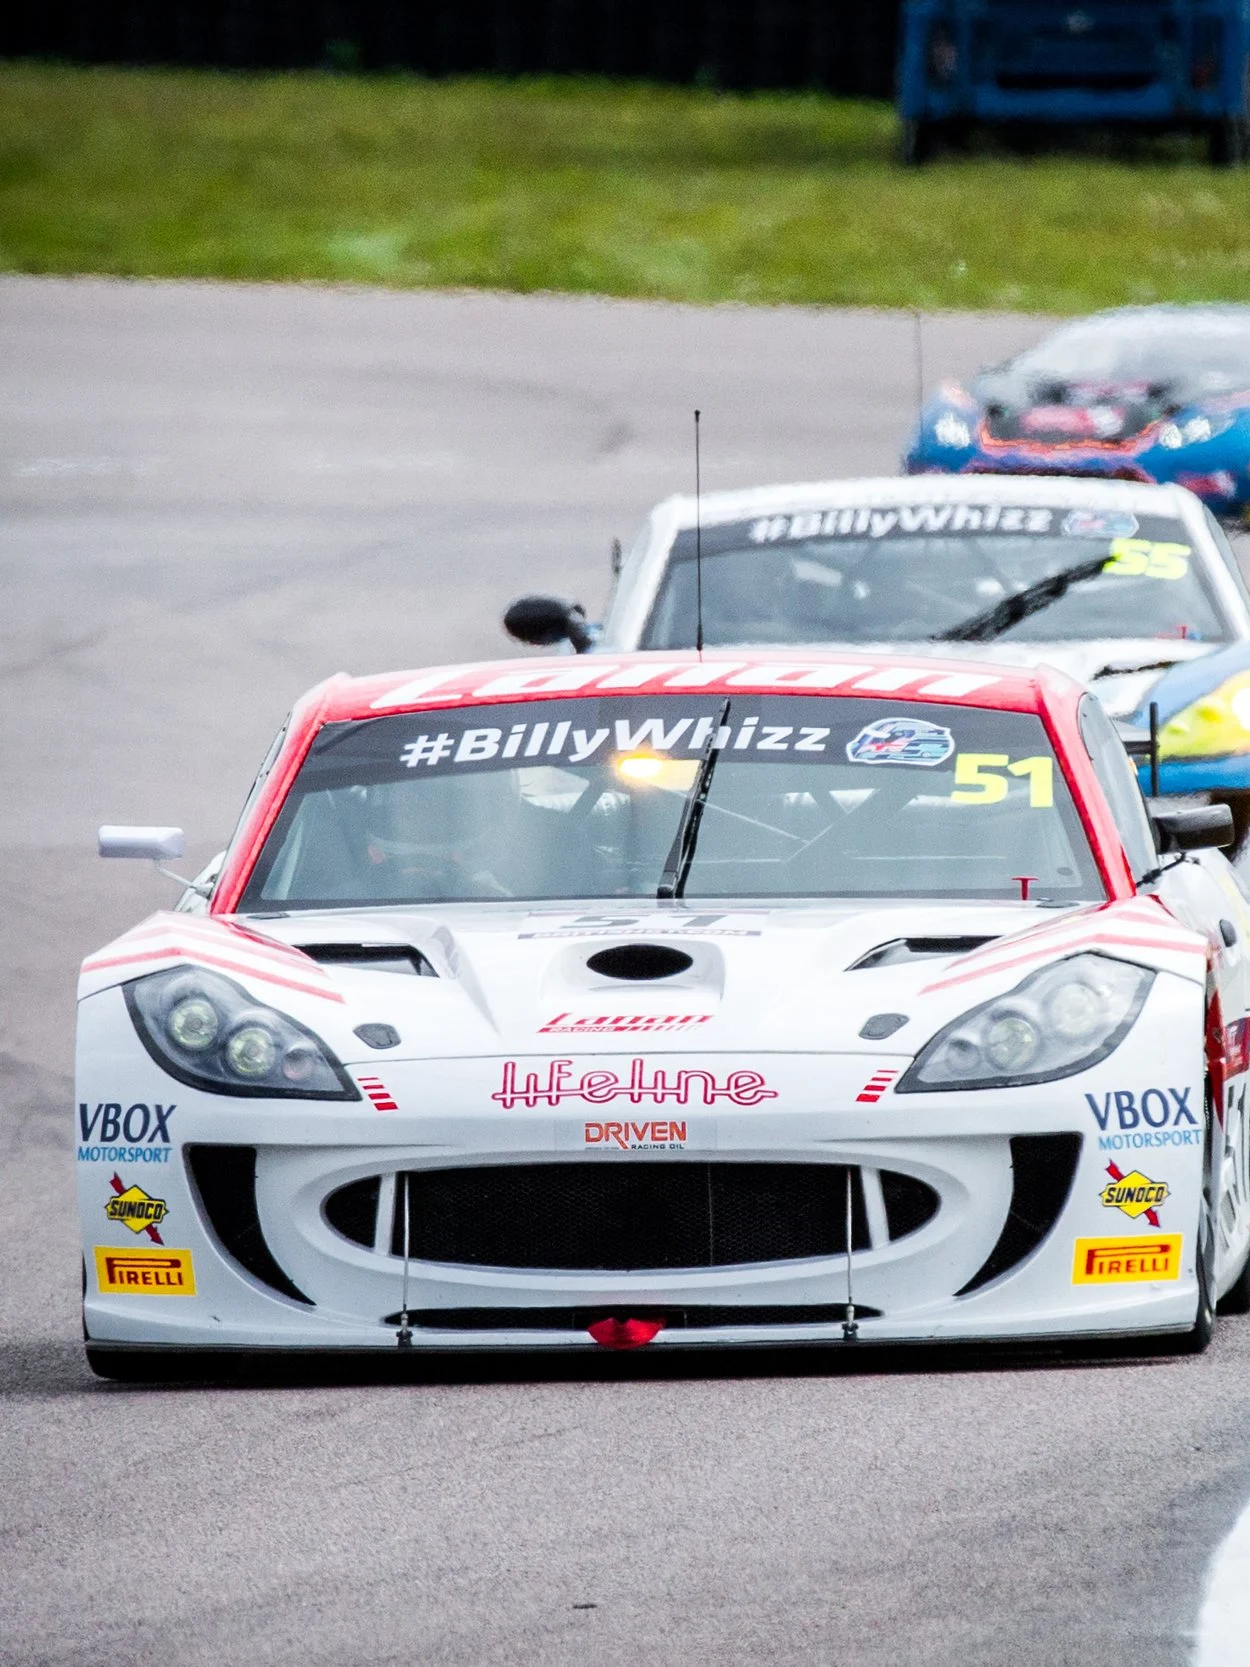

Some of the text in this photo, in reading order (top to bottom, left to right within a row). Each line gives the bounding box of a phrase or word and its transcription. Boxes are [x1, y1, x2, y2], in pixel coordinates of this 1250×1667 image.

[748, 504, 1053, 542] #BillyWhizz
[1102, 537, 1191, 580] 55
[370, 661, 1003, 709] Lanan
[400, 716, 832, 767] #BillyWhizz
[951, 753, 1054, 808] 51
[79, 1103, 177, 1143] VBOX
[1085, 1087, 1199, 1131] VBOX
[584, 1120, 687, 1149] DRIVEN
[1098, 1129, 1202, 1151] MOTORSPORT
[77, 1146, 173, 1163] MOTORSPORT
[109, 1199, 164, 1220] SUNOCO
[1104, 1186, 1165, 1203] SUNOCO
[105, 1256, 184, 1286] PIRELLI
[1085, 1244, 1171, 1275] PIRELLI
